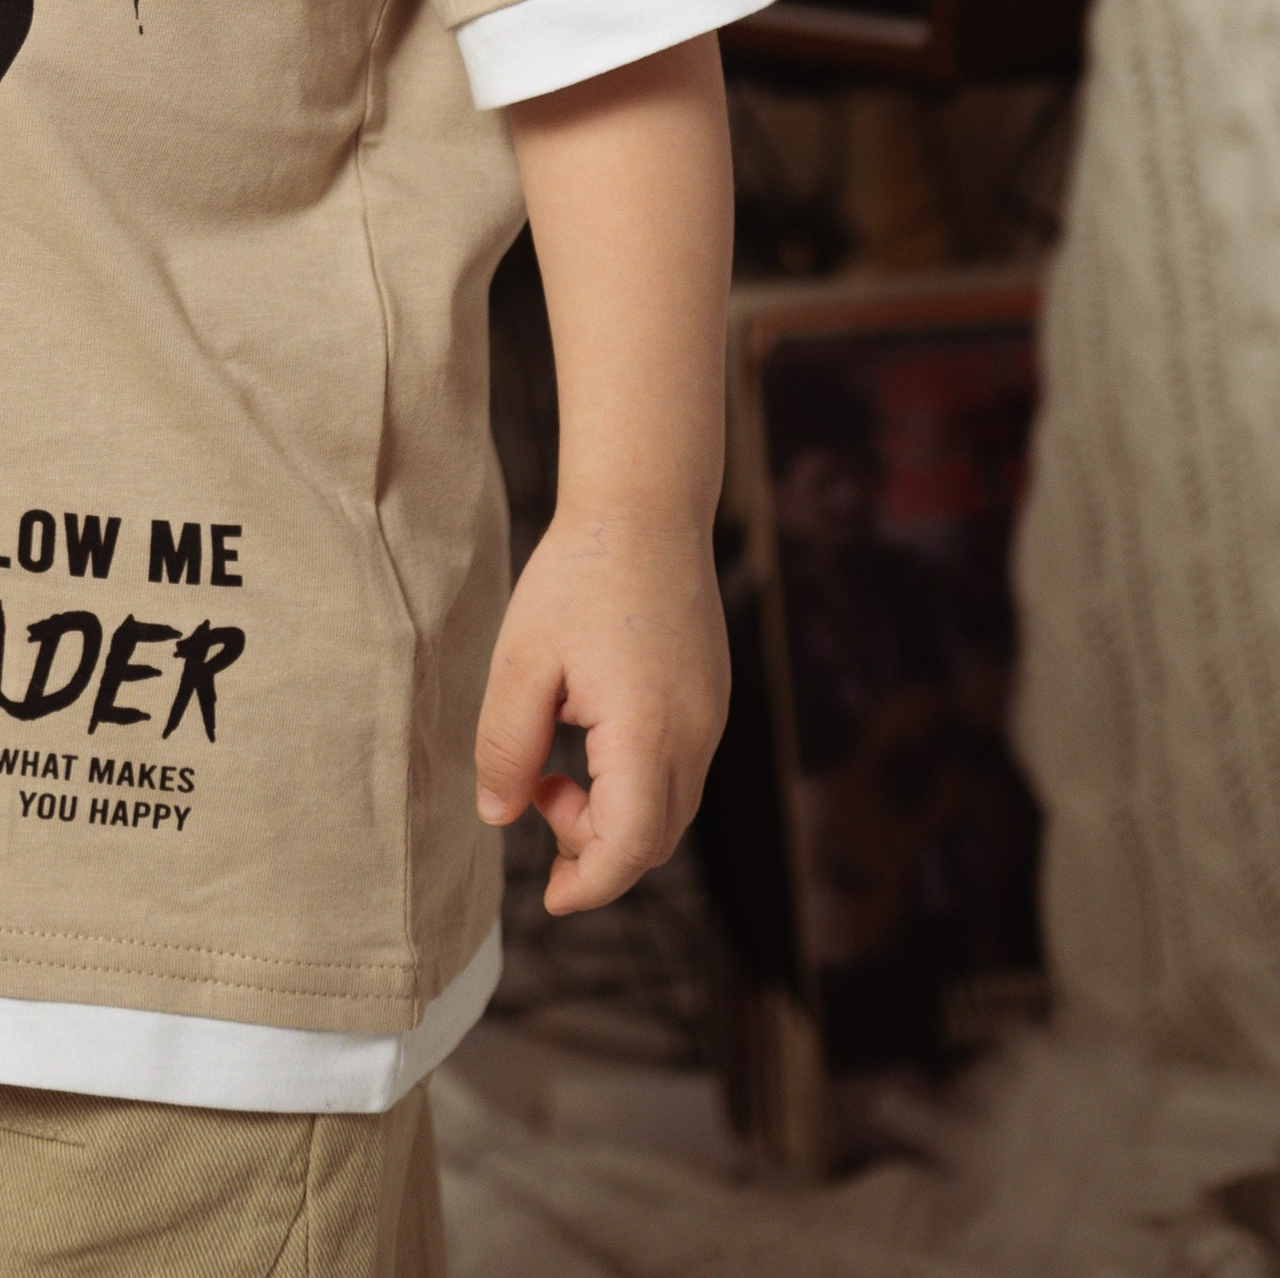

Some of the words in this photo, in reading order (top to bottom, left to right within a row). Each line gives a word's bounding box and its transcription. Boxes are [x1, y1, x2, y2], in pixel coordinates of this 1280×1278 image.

[147, 519, 243, 588] ME
[88, 756, 196, 794] MAKES
[19, 790, 78, 822] YOU
[88, 797, 192, 832] HAPPY
